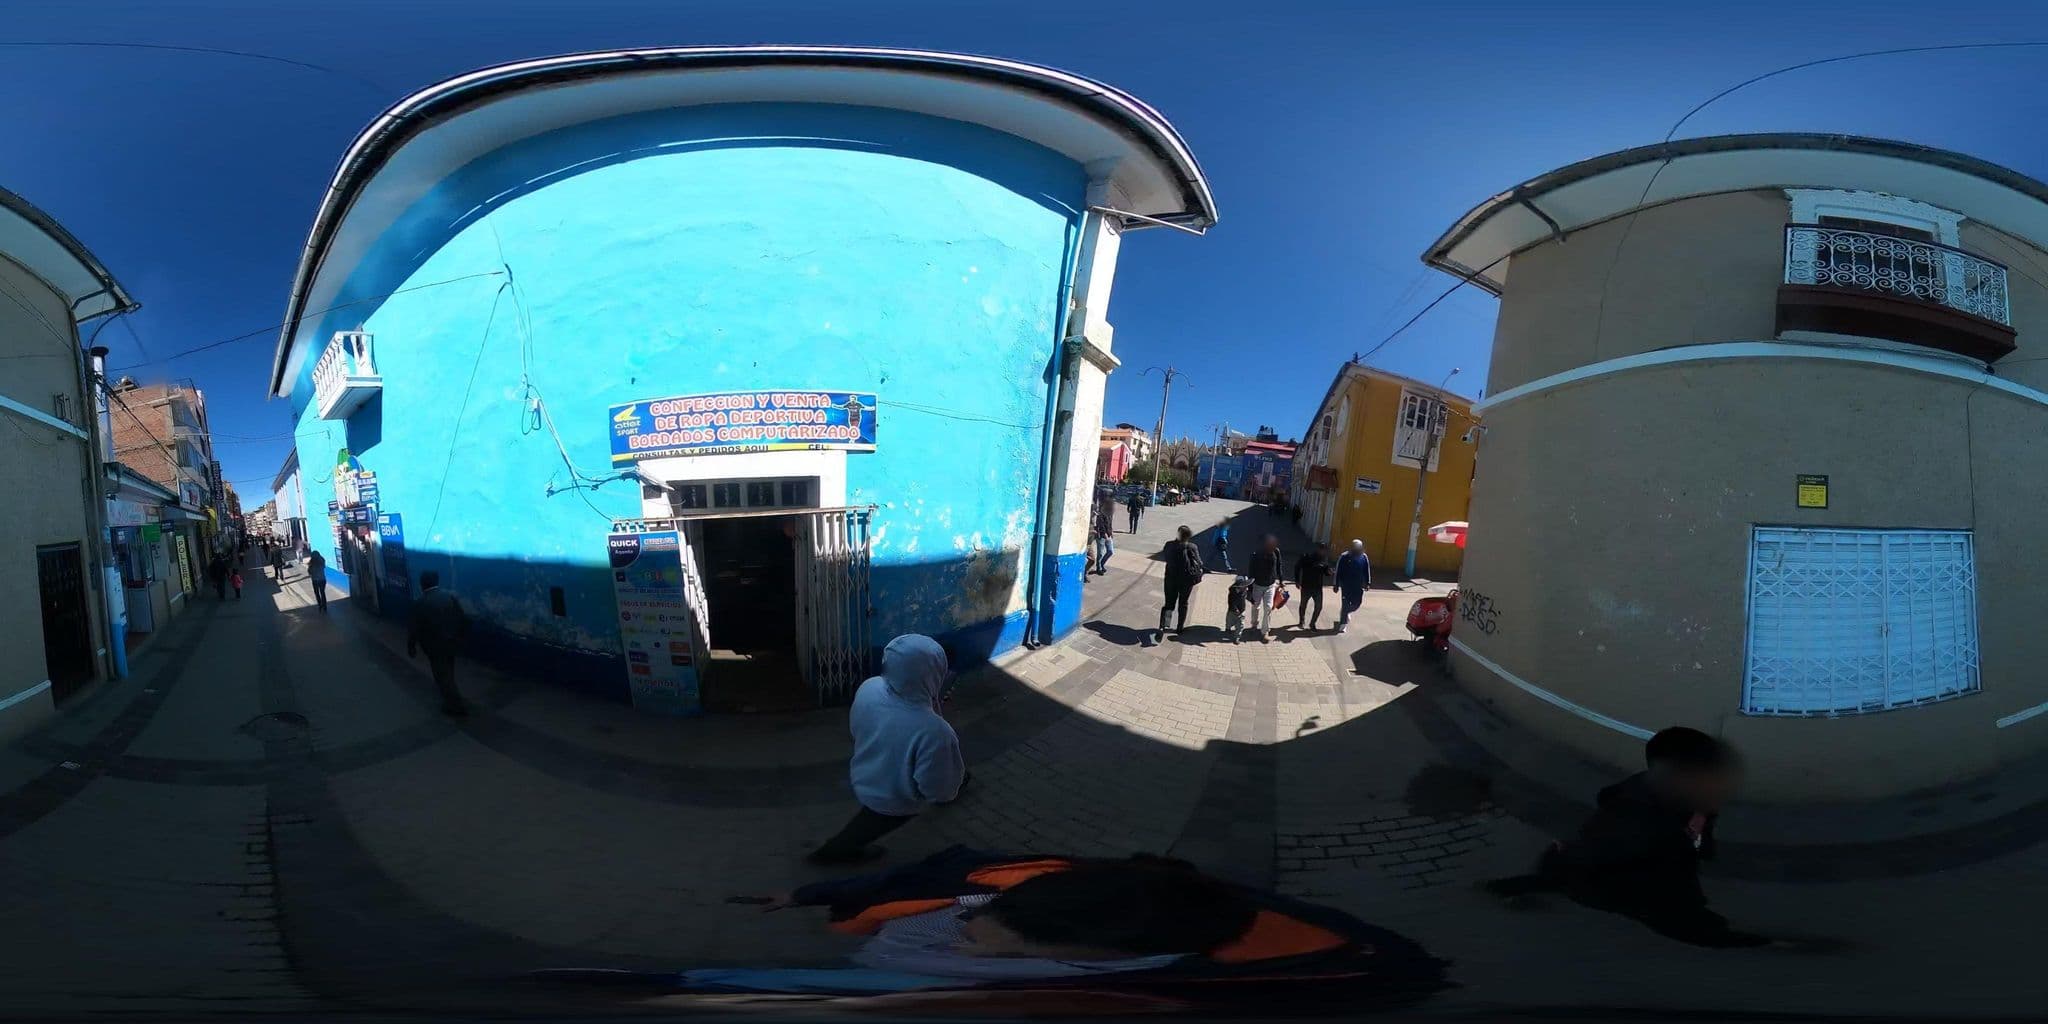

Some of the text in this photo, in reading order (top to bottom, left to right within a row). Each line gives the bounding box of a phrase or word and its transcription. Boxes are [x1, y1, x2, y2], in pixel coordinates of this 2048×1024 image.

[650, 393, 832, 416] CONFECCION Y VENTA
[655, 409, 827, 431] DE ROPA DEPORTIVA
[629, 424, 861, 449] BORDADOS COMPUTARIZADO
[632, 449, 686, 459] CONSULTAS
[699, 444, 741, 456] PEDIDOS
[744, 444, 769, 452] AQUI
[380, 524, 400, 536] BBVA
[610, 538, 638, 548] QUICK
